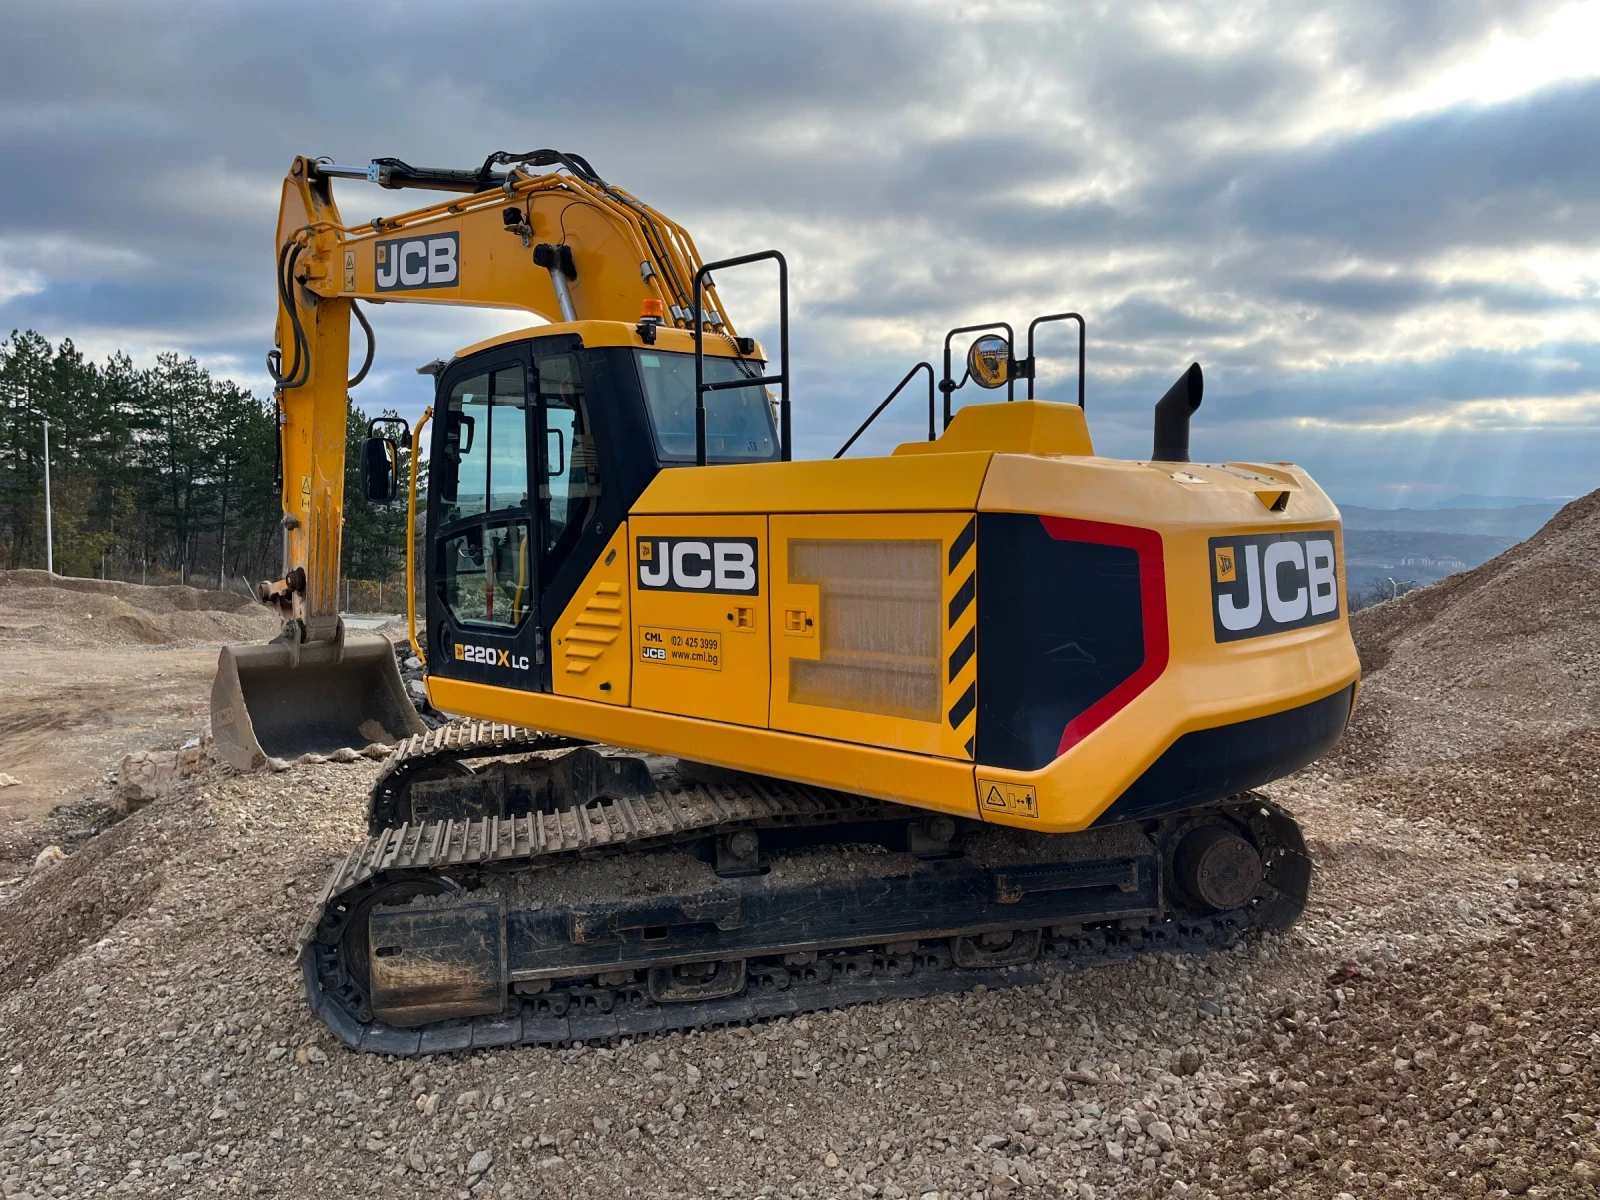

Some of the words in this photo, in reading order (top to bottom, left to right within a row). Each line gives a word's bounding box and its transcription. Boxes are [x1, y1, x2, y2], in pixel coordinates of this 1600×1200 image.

[377, 237, 457, 288] JCB
[640, 541, 756, 591] JCB
[1218, 540, 1337, 631] JCB
[645, 632, 662, 642] CML
[671, 636, 683, 646] (02)
[685, 637, 698, 647] 425
[700, 638, 718, 649] 3999
[464, 644, 511, 668] 220X
[512, 654, 530, 671] LC
[643, 648, 666, 659] JCB
[672, 651, 718, 665] www.cml.bg
